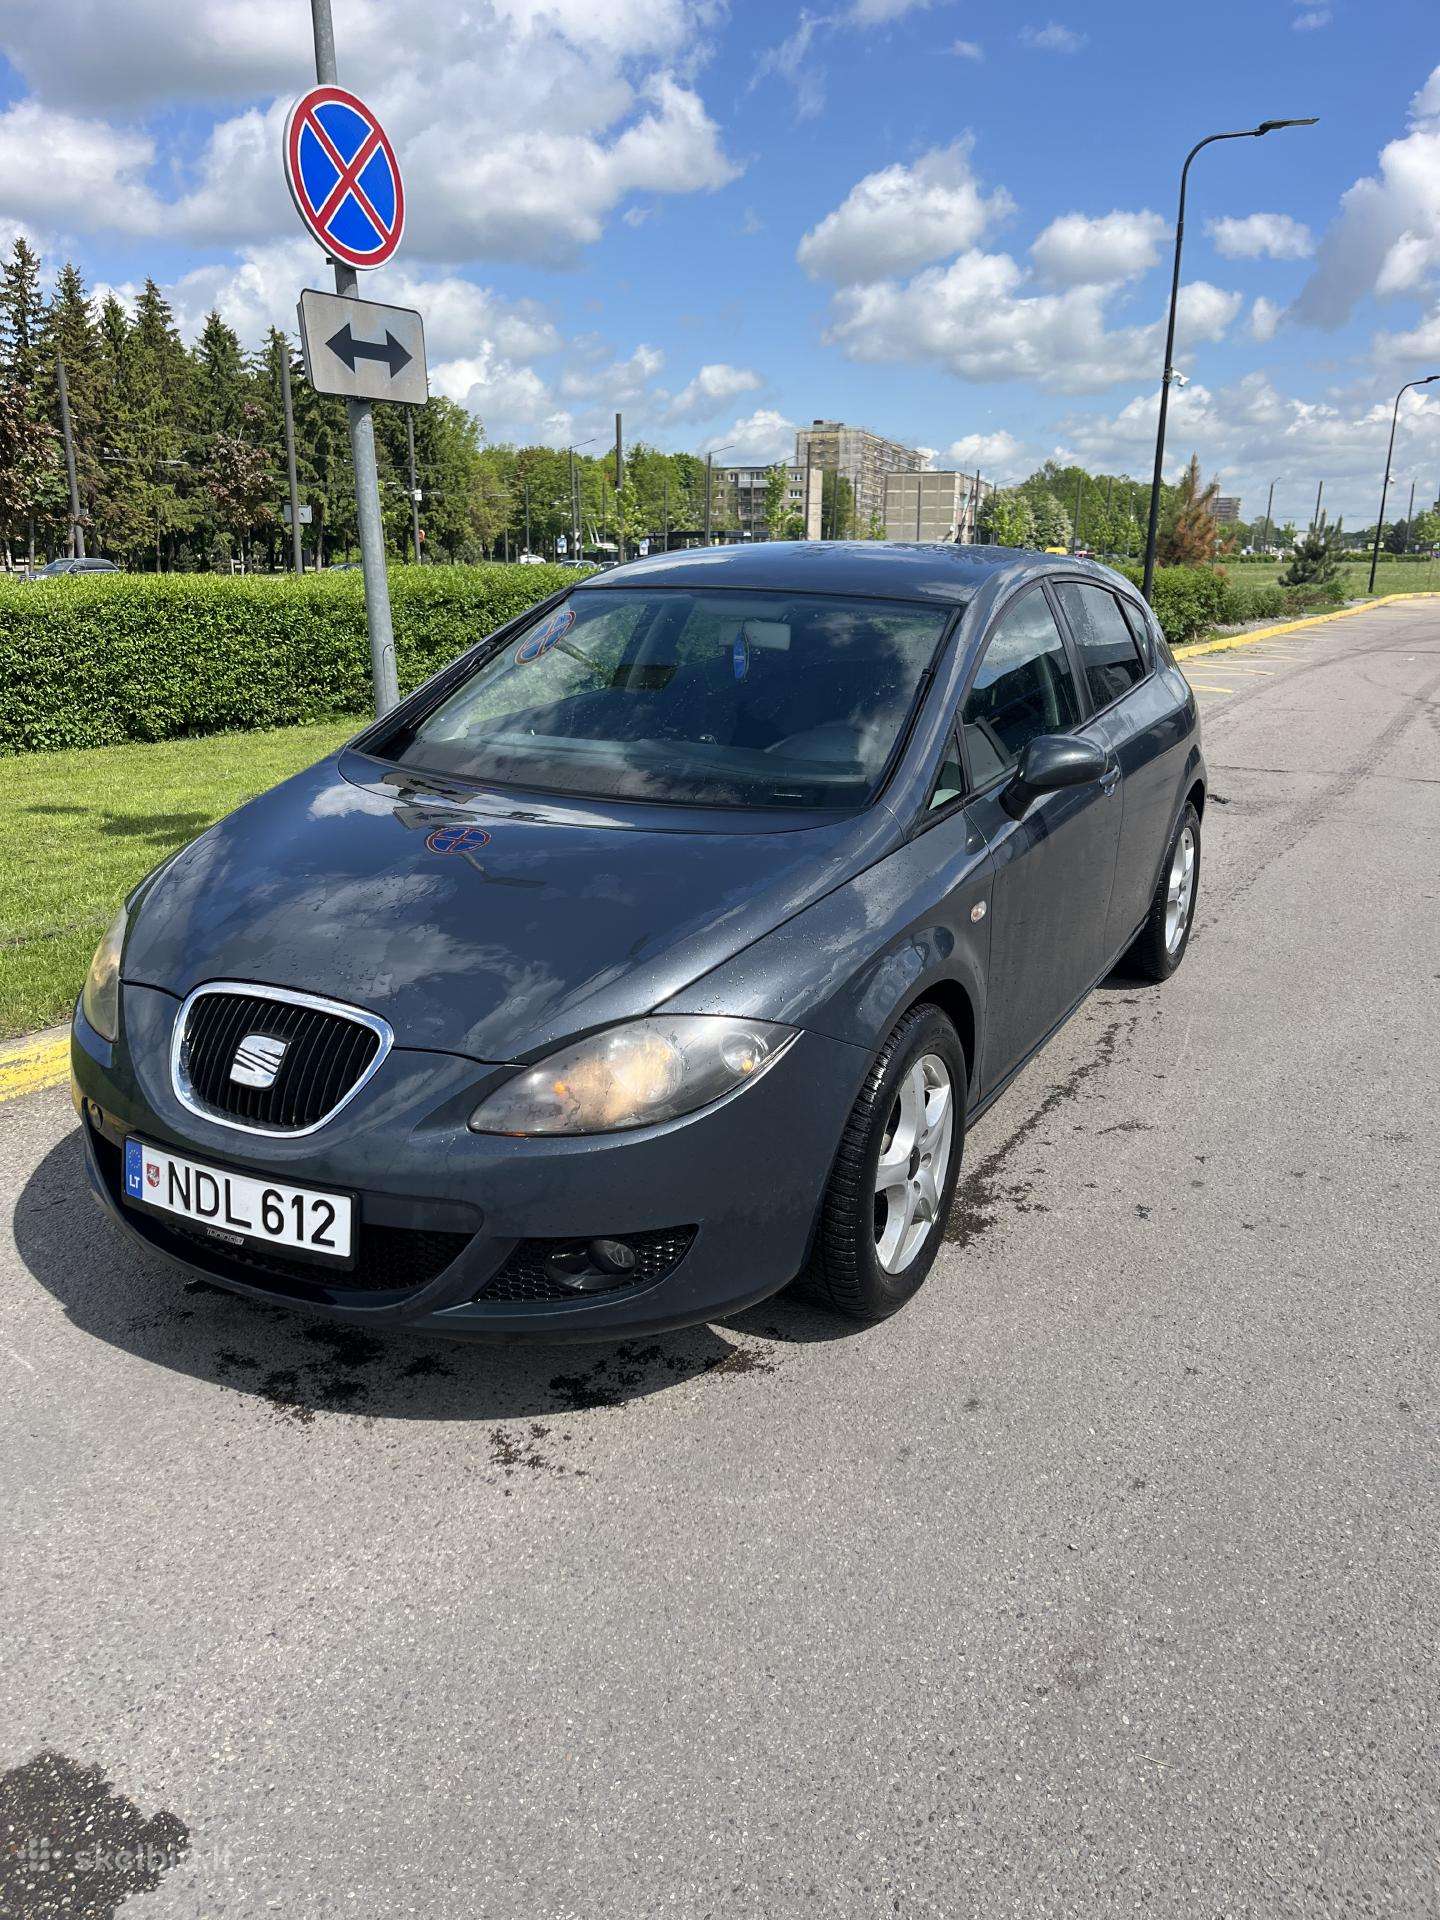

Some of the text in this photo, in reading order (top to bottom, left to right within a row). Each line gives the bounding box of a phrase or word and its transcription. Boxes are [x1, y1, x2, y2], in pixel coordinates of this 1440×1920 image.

[129, 1175, 141, 1189] LT
[168, 1160, 336, 1248] NDL 612
